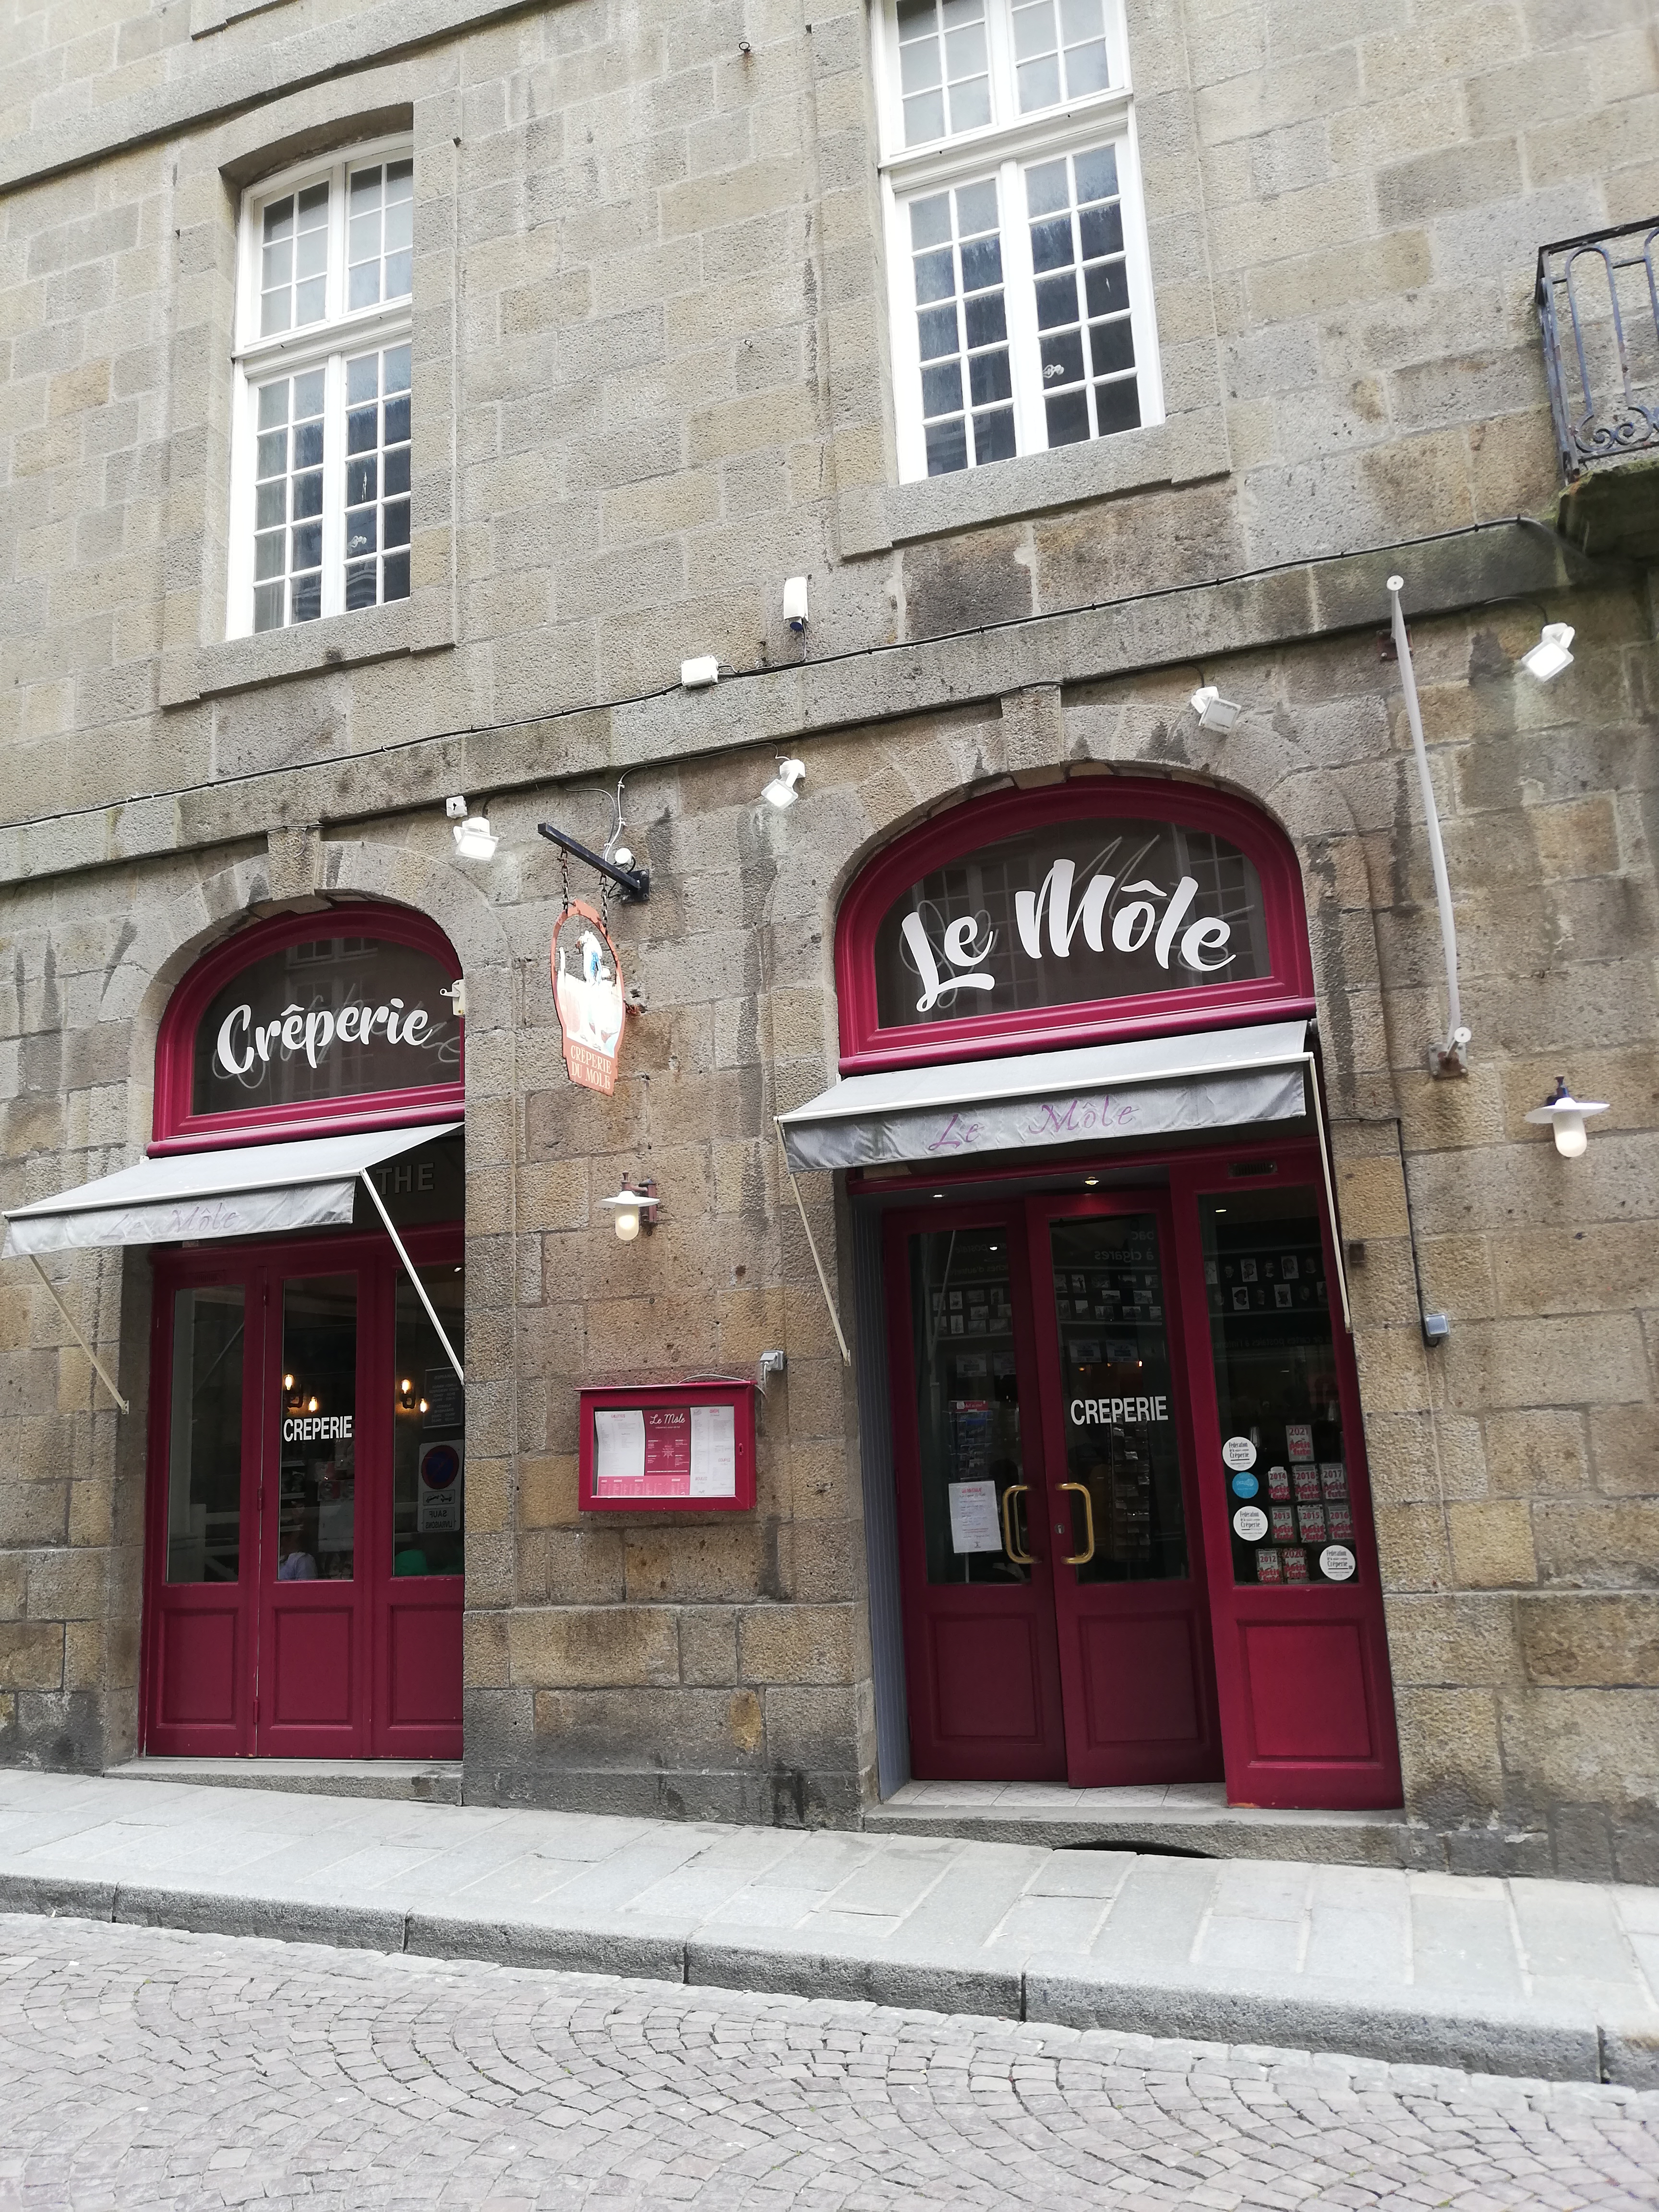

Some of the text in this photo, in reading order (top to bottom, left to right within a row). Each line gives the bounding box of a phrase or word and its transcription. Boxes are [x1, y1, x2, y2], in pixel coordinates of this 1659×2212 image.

[902, 859, 1236, 1012] Le Môle
[217, 998, 433, 1074] Crêperie
[570, 1045, 612, 1074] CRÊPERIE
[571, 1061, 611, 1090] DU MOLE
[929, 1094, 1141, 1151] Le Môle
[375, 1162, 434, 1195] THE
[649, 1413, 686, 1425] Le Môle
[1070, 1395, 1169, 1425] CREPERIE
[283, 1416, 352, 1442] CREPERIE
[1289, 1427, 1308, 1435] 2021
[1296, 1471, 1315, 1479] 2018
[1324, 1470, 1342, 1478] 2017
